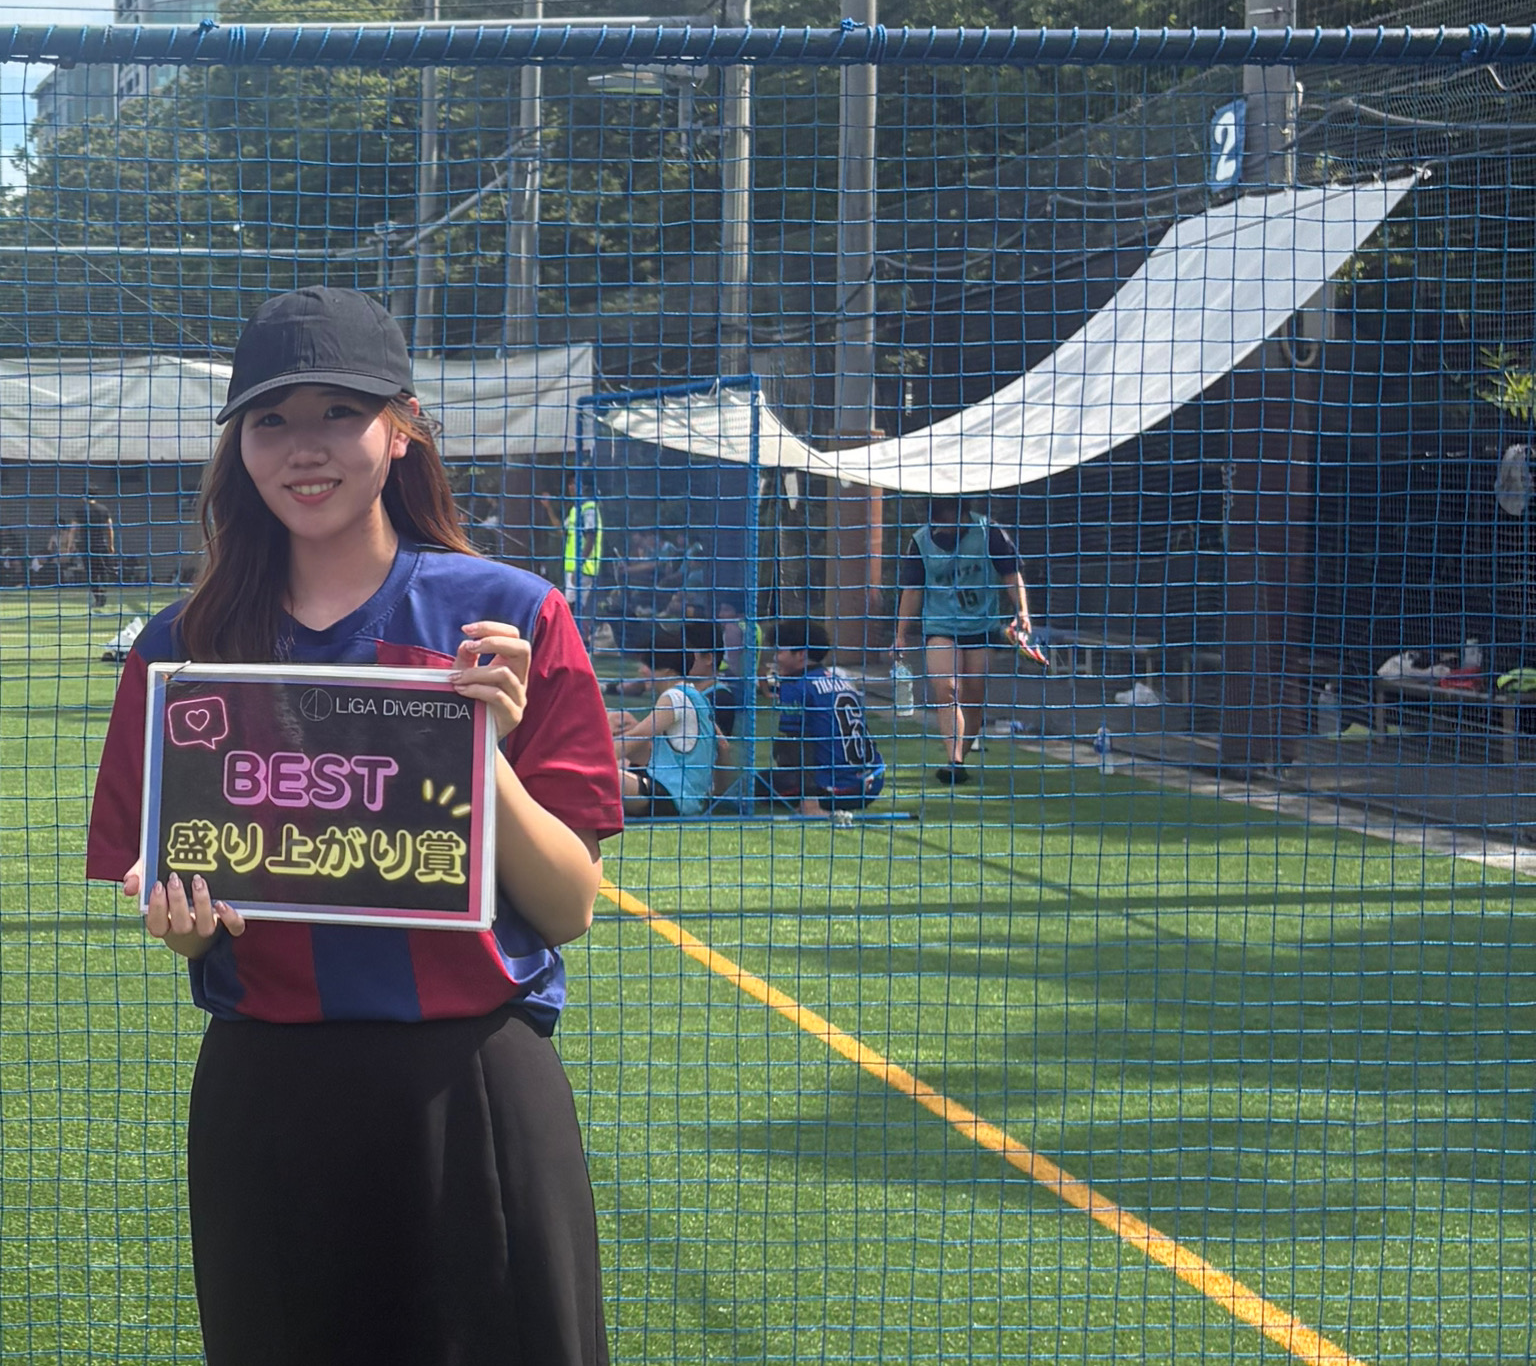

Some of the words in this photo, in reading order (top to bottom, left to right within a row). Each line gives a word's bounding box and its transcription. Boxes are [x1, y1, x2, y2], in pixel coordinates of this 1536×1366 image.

[1214, 111, 1237, 182] 2
[834, 692, 875, 767] 6
[223, 750, 399, 812] BEST
[166, 819, 467, 885] 盛り上がり賞
